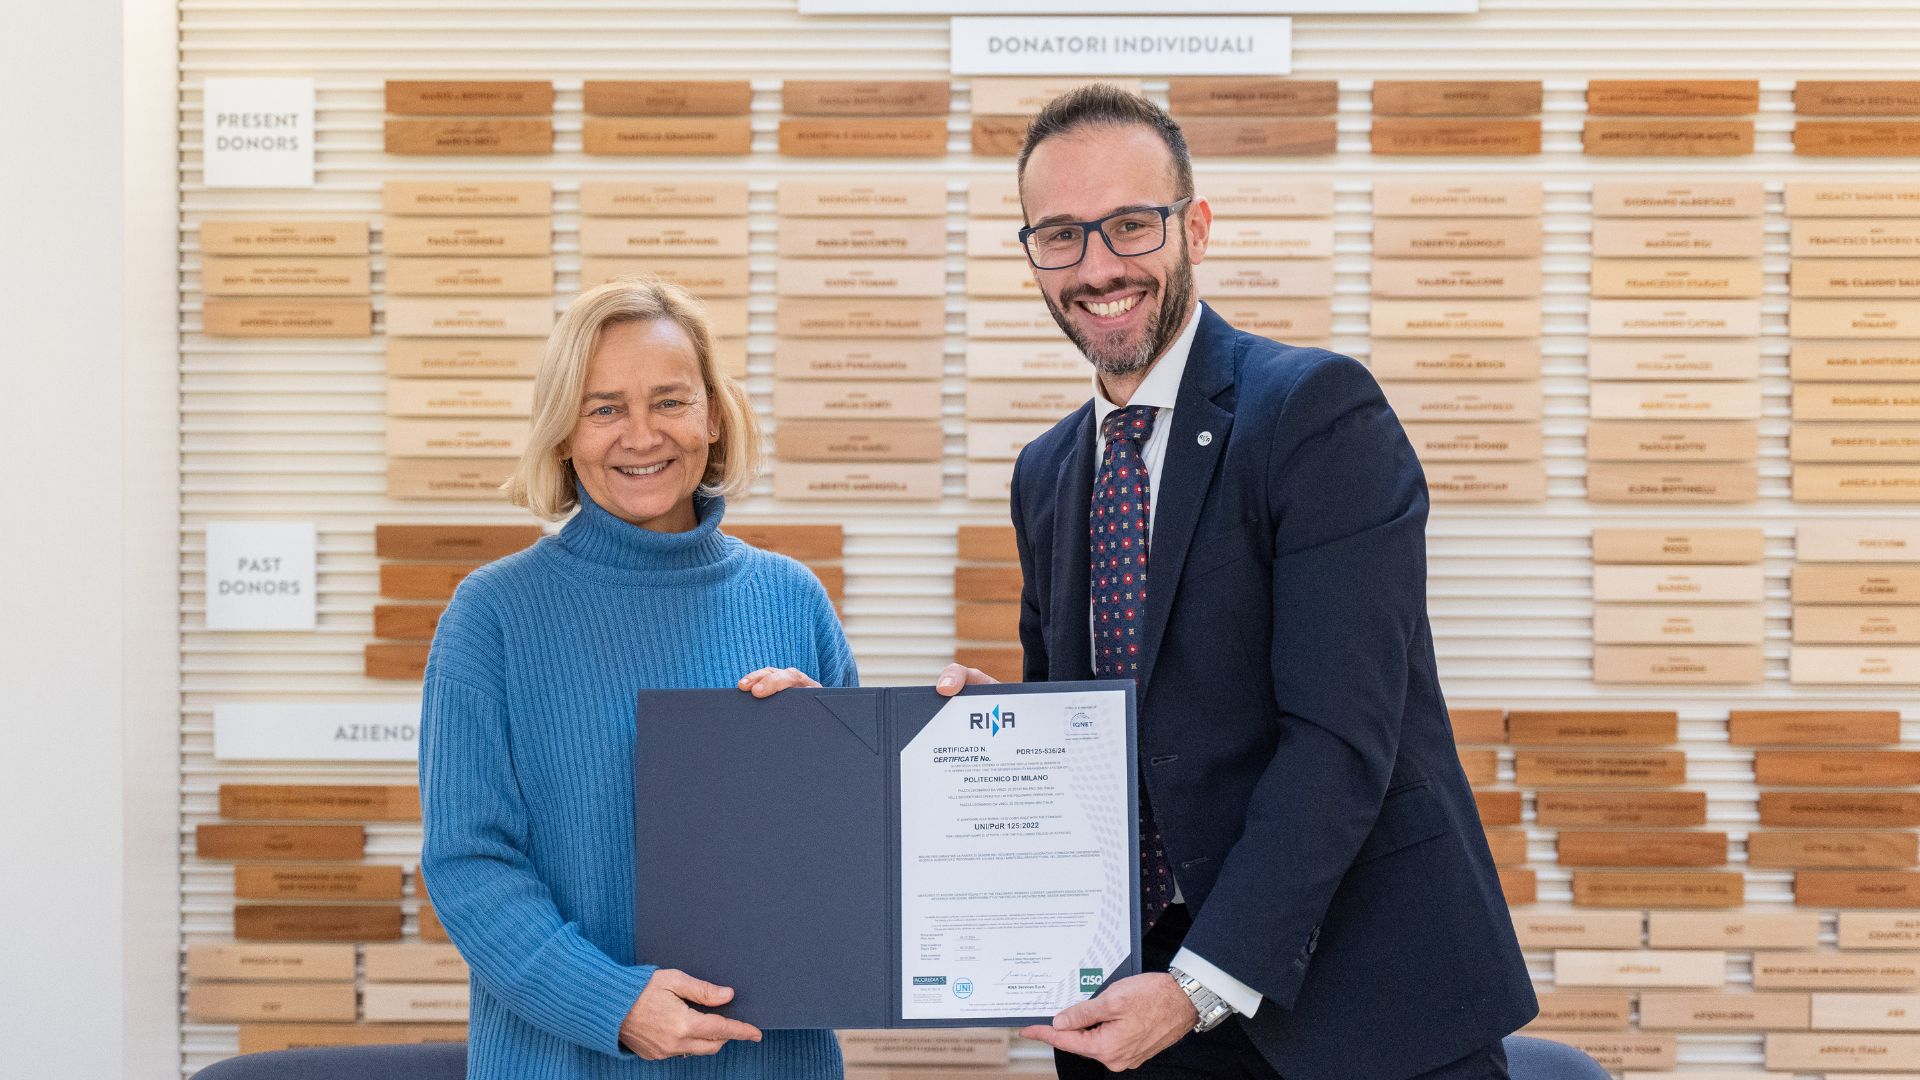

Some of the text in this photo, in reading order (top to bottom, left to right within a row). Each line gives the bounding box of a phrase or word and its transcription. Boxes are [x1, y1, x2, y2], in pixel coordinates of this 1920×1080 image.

[988, 37, 1253, 53] DONATORI INDIVIDUALI
[216, 113, 297, 127] PRESENT
[216, 137, 298, 150] DONORS
[238, 558, 280, 571] PAST
[218, 581, 300, 594] DONORS
[334, 724, 416, 742] AZIEND
[933, 746, 979, 754] CERTIFICATO
[933, 755, 979, 763] CERTIFICATE
[1021, 774, 1048, 782] MILANO
[974, 821, 1040, 831] UNI/PdR 125:2022
[1080, 975, 1103, 986] CISQ
[955, 983, 971, 991] UNI
